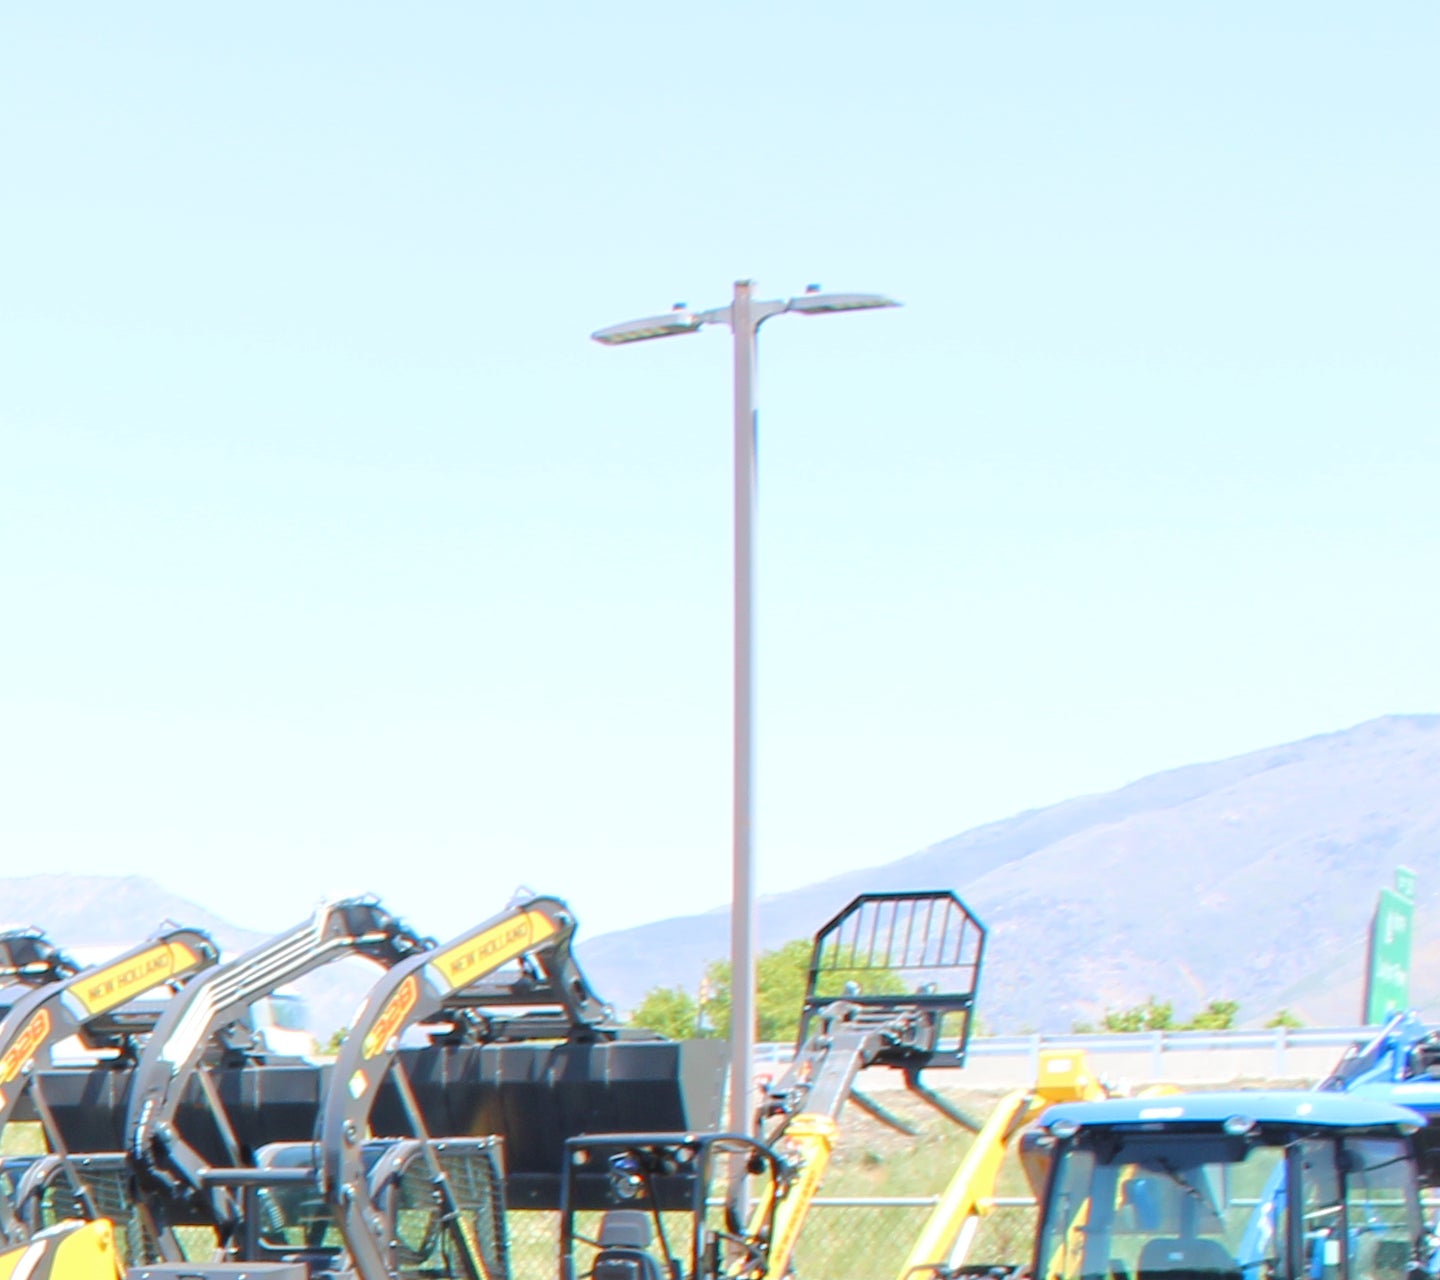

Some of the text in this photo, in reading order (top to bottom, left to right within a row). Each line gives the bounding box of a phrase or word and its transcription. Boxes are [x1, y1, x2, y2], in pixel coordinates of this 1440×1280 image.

[449, 920, 529, 977] NEW HOLLAND
[87, 952, 169, 1002] NEW HOLLAND
